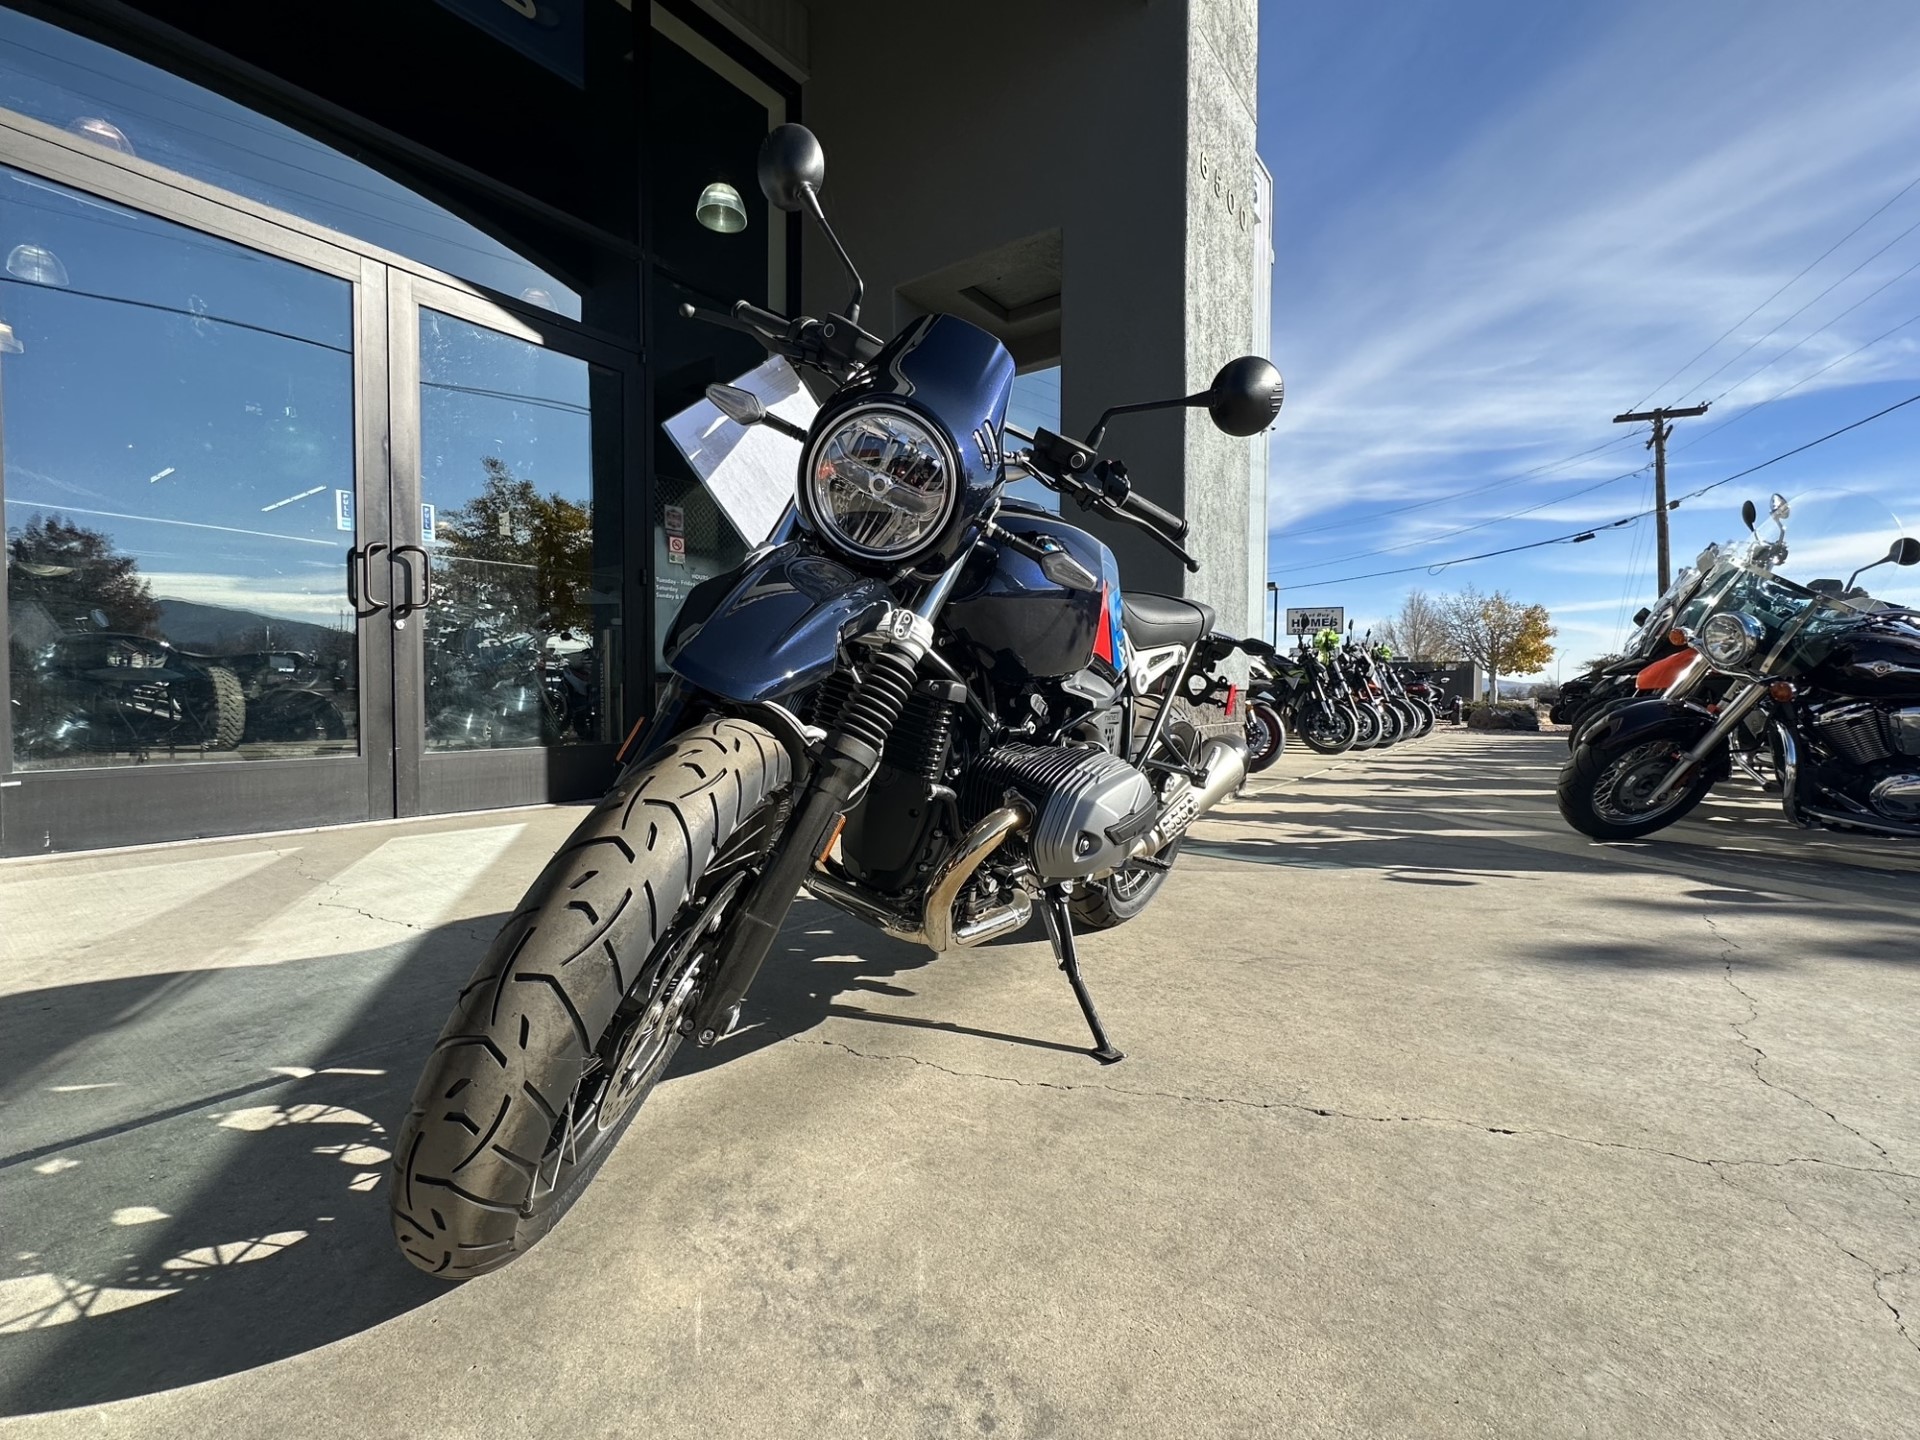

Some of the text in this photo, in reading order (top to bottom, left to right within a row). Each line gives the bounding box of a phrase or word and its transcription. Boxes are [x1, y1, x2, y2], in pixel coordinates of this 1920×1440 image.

[655, 576, 676, 585] Tuesday
[681, 579, 696, 587] Friday
[655, 584, 678, 593] Saturday
[655, 592, 675, 600] Sunday
[1291, 618, 1338, 628] HMES
